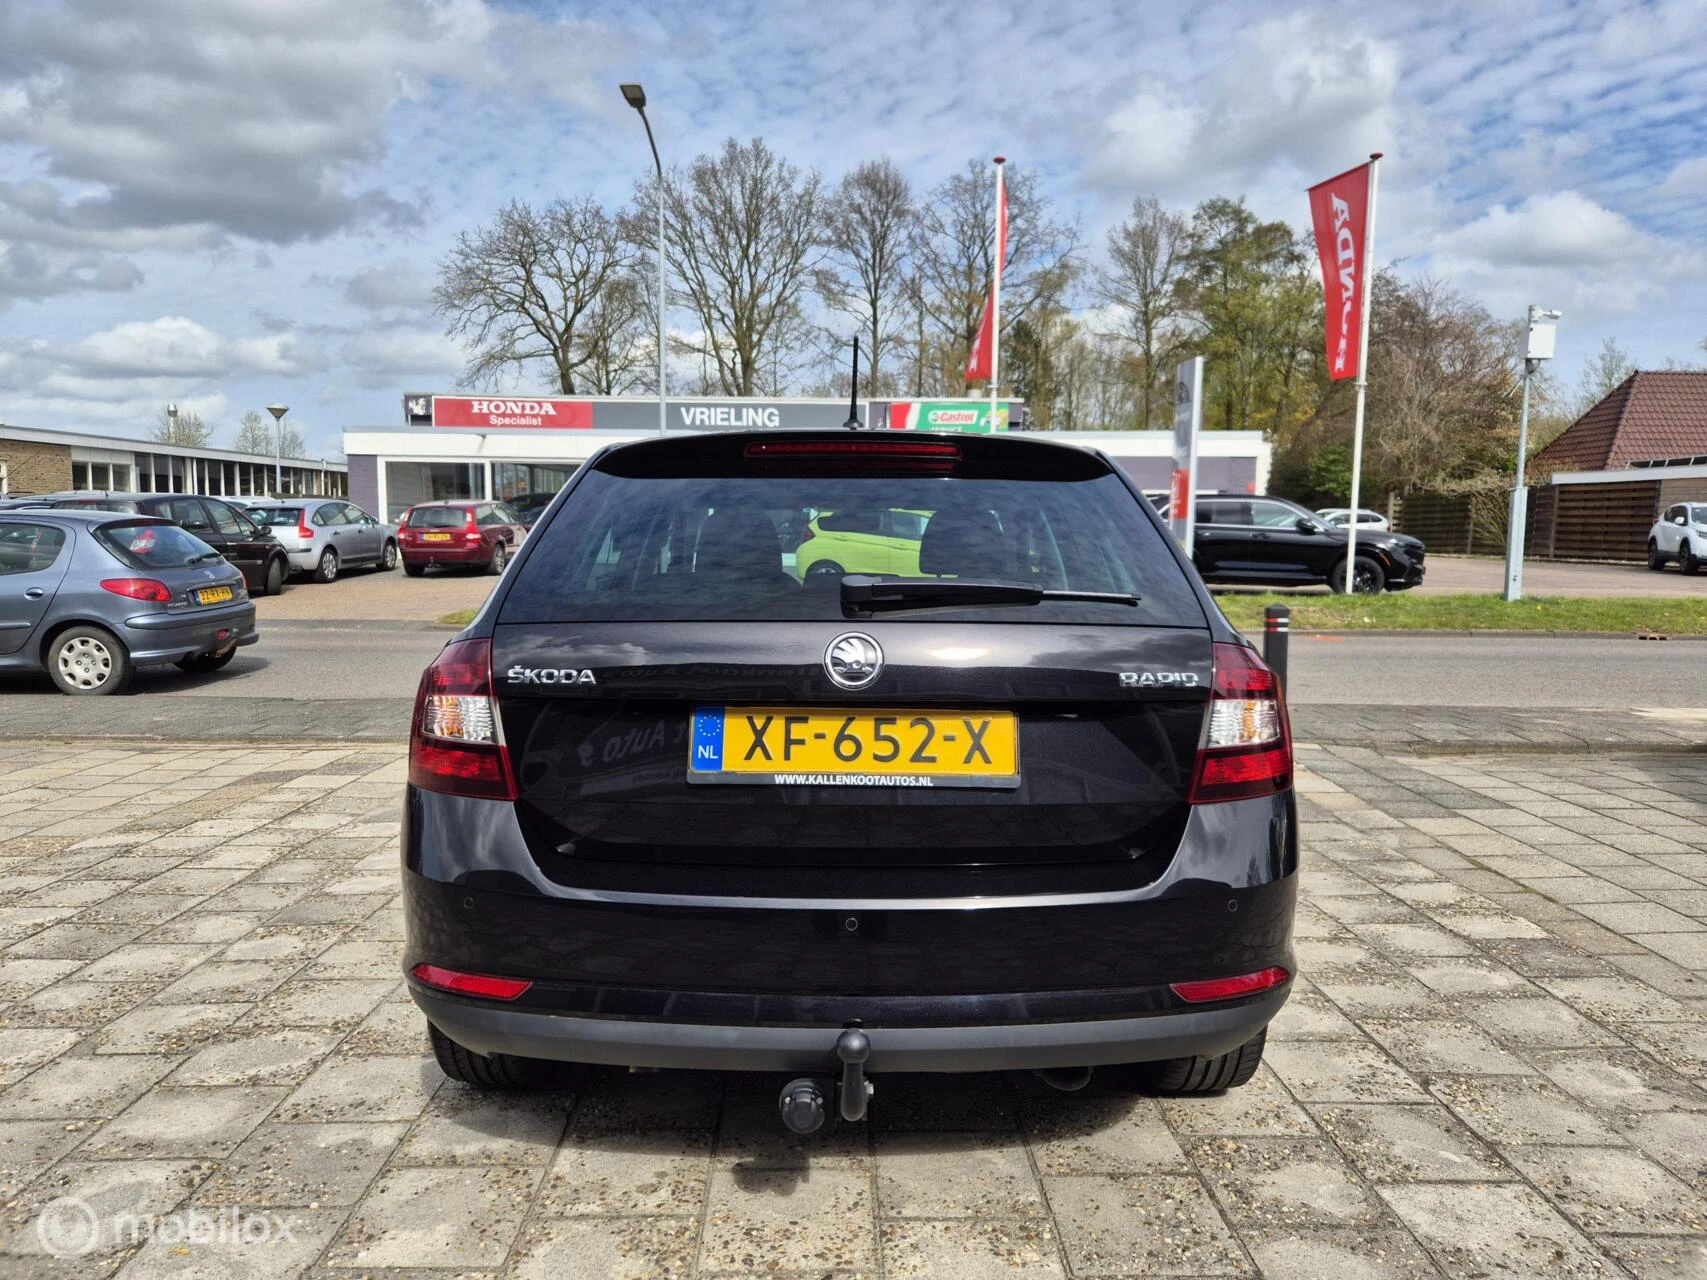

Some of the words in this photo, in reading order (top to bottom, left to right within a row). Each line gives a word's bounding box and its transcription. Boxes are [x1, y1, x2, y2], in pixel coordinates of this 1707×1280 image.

[471, 400, 557, 415] HONDA
[489, 415, 542, 426] Specialist
[680, 406, 780, 428] VRIELING
[940, 411, 974, 423] Castrol
[506, 665, 597, 686] ŠKODA
[1119, 672, 1199, 688] RAPID
[744, 714, 993, 765] XF-652-X
[697, 745, 719, 760] NL
[774, 774, 934, 788] WWW.KALLENKOOTAUTOS.NL
